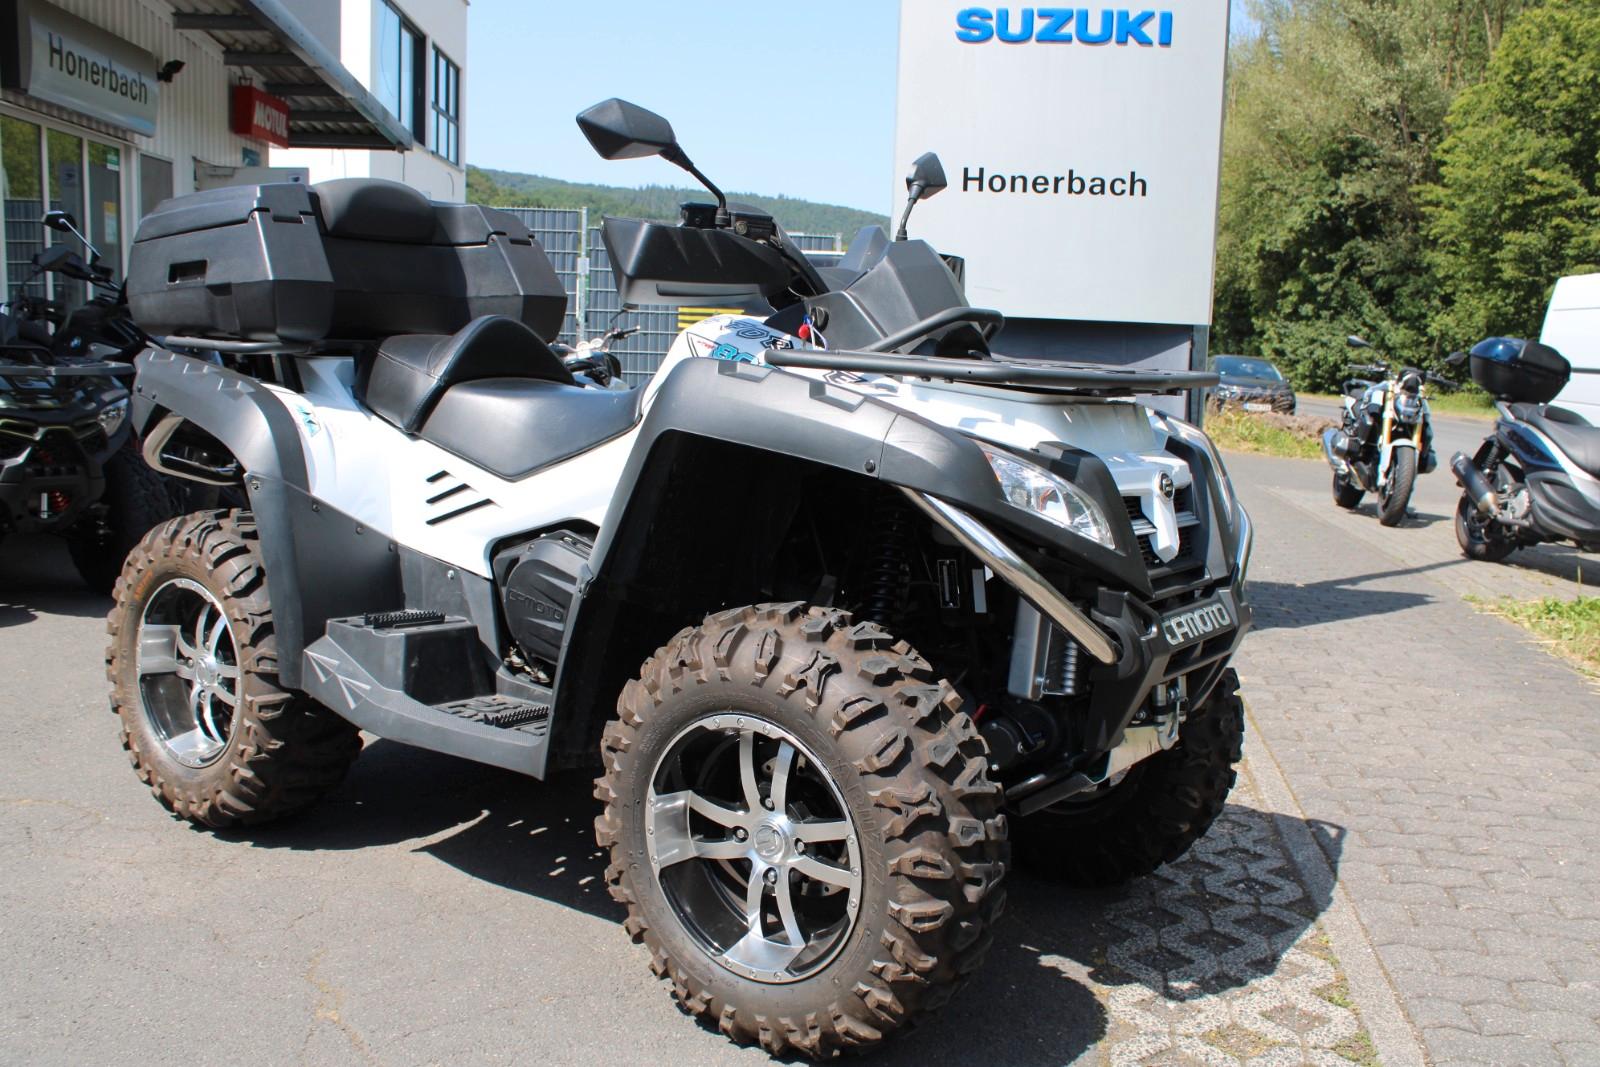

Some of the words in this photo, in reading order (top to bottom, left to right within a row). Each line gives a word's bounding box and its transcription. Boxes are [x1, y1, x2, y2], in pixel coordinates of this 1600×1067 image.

[954, 7, 1173, 47] SUZUKI
[47, 31, 148, 105] Honerbach
[253, 100, 289, 138] MOTUL
[962, 167, 1148, 197] Honerbach
